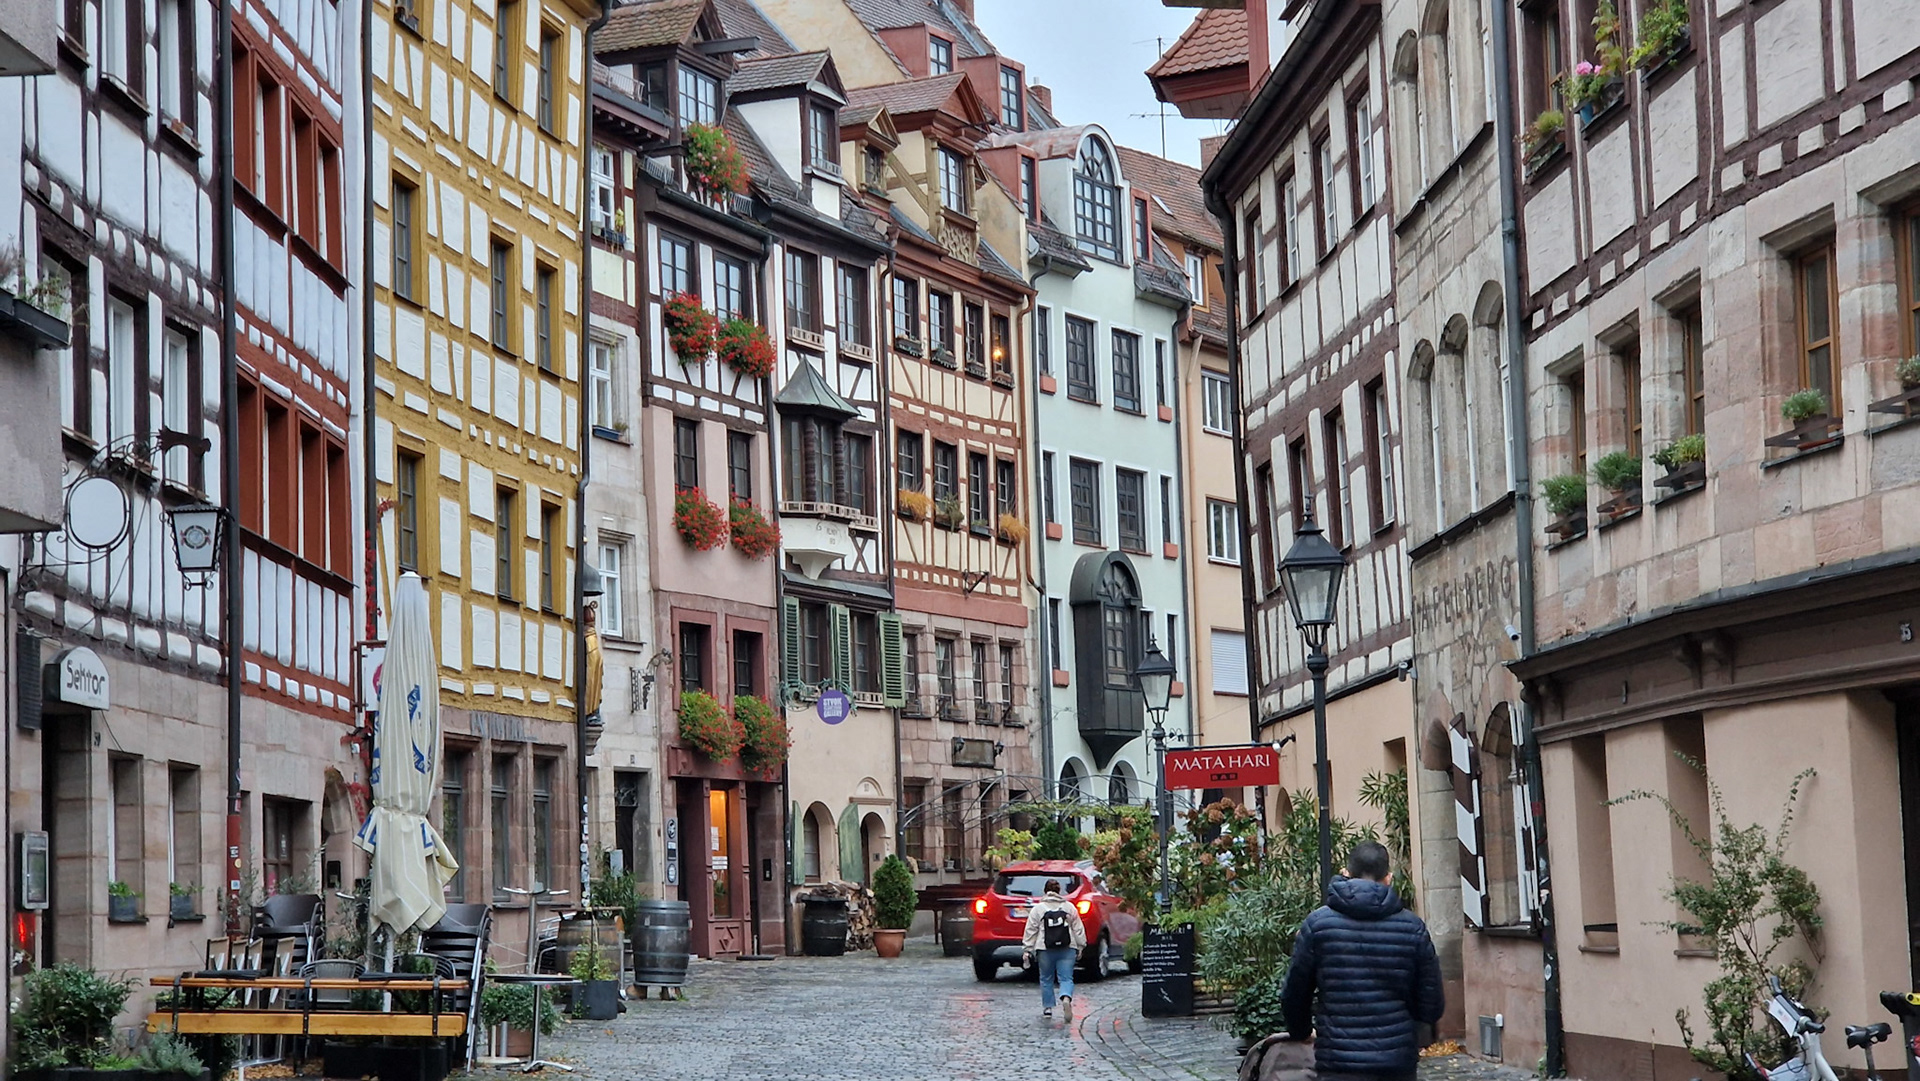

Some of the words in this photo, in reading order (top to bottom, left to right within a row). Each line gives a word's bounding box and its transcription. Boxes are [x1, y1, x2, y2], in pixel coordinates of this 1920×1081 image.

[66, 660, 105, 695] Sektor
[1173, 755, 1226, 772] MATA
[1228, 753, 1271, 769] HARI
[1211, 773, 1237, 781] BAR
